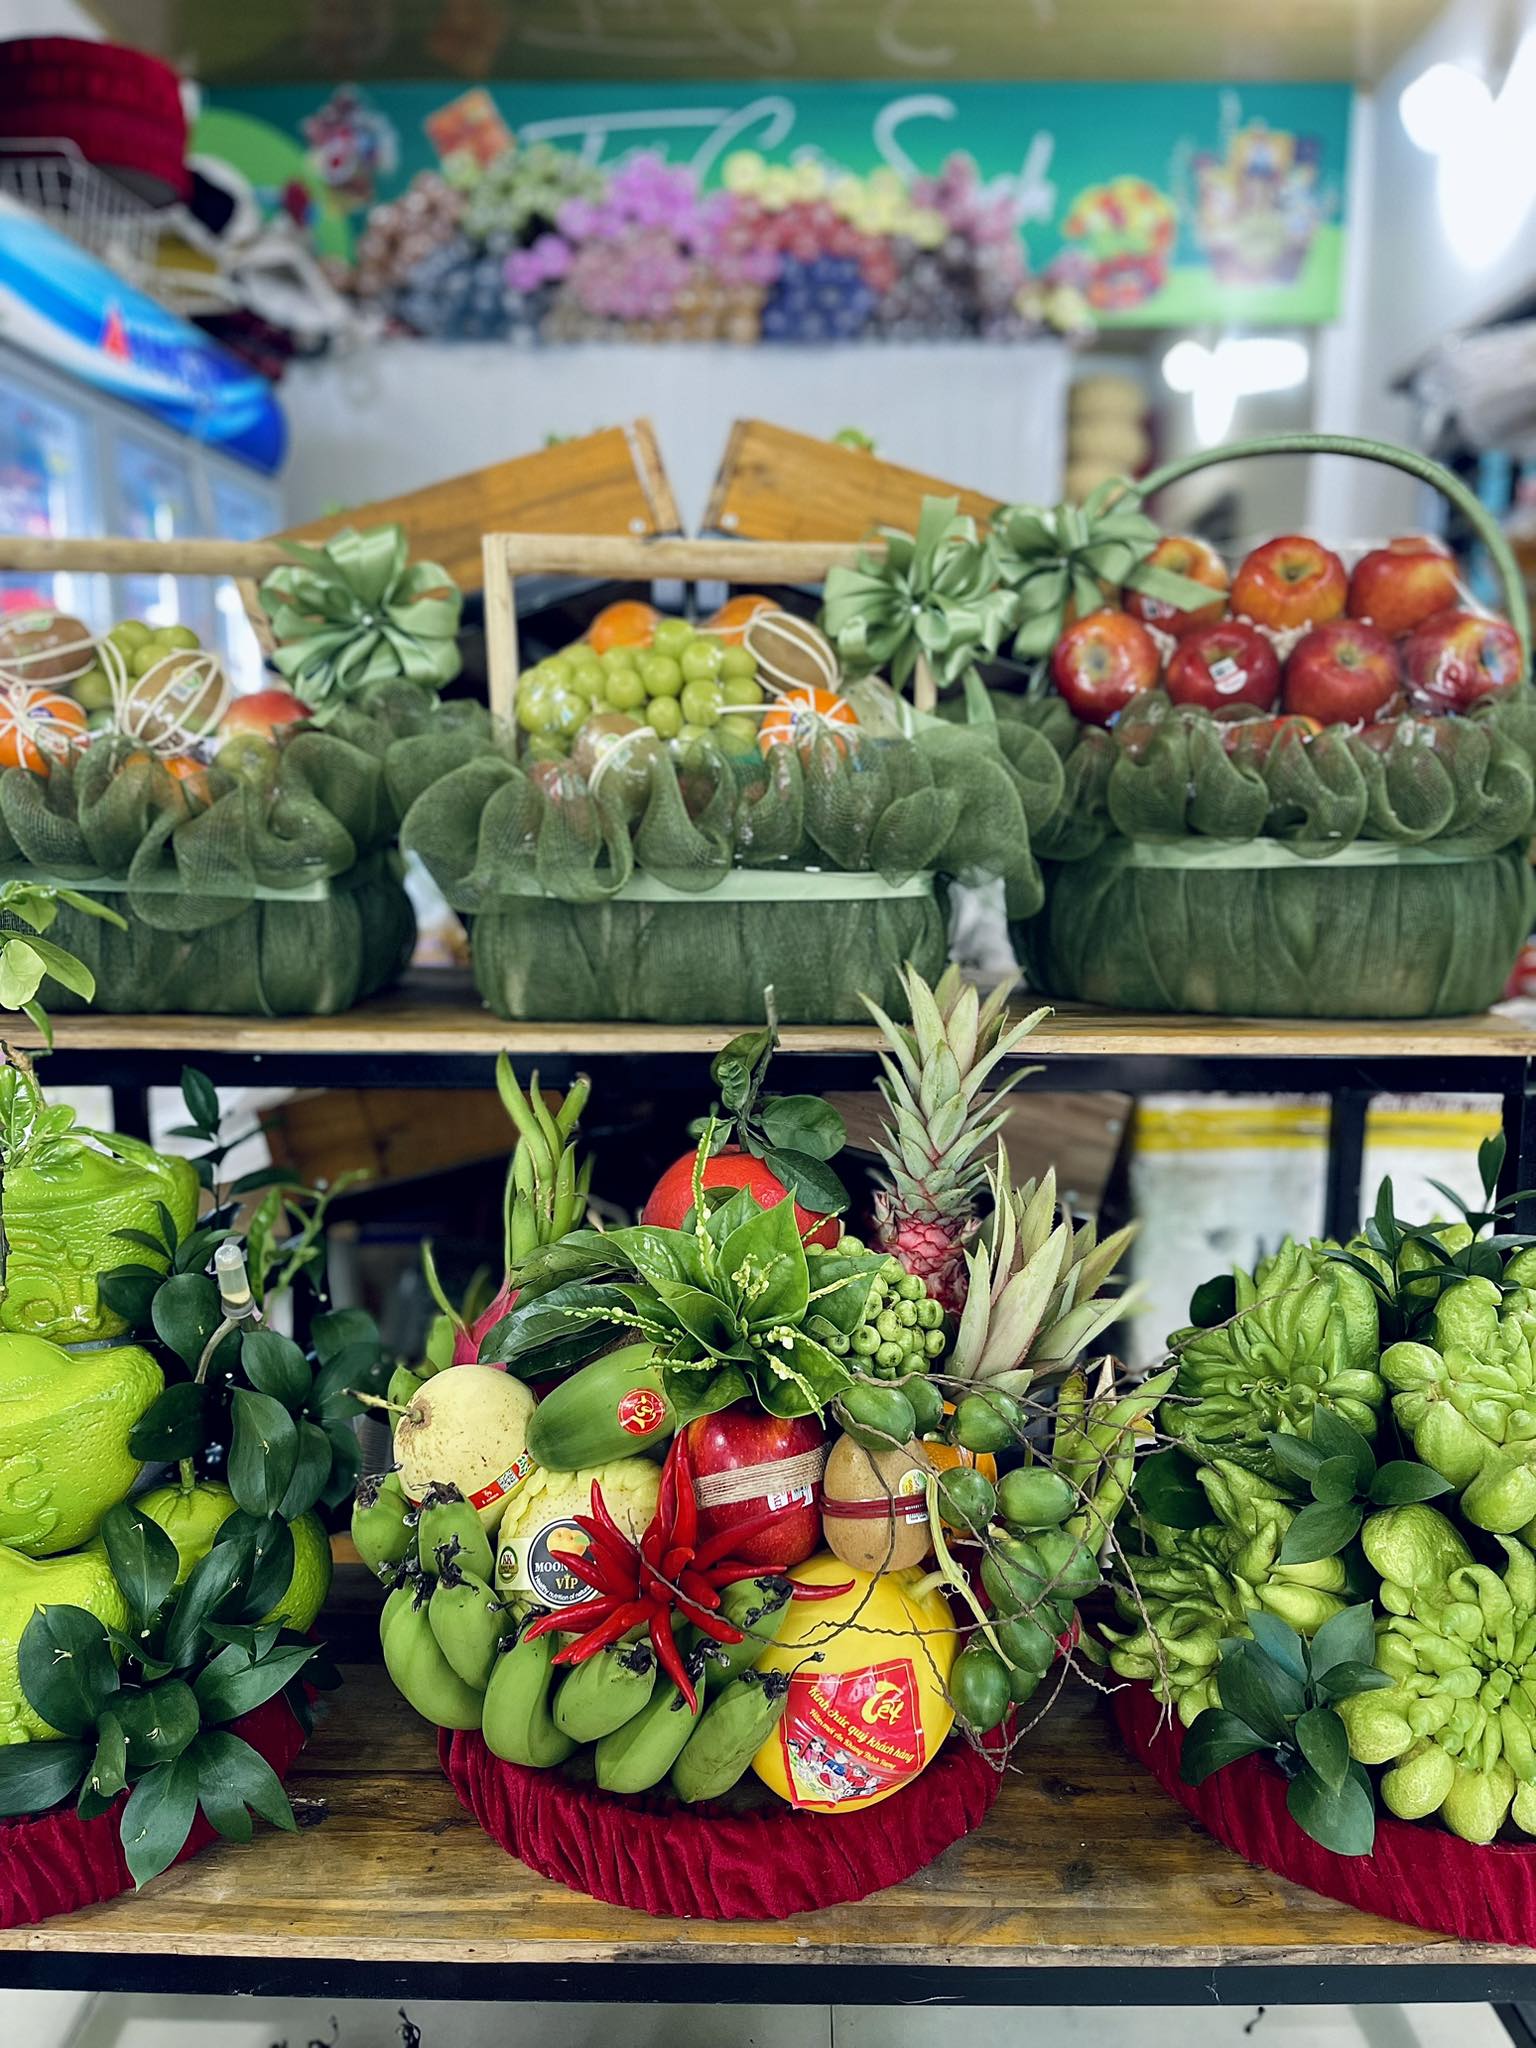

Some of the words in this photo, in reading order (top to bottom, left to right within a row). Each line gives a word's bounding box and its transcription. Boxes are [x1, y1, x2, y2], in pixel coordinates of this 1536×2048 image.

[555, 1576, 578, 1589] VIP
[807, 1685, 829, 1711] Kính
[828, 1708, 850, 1729] chúc
